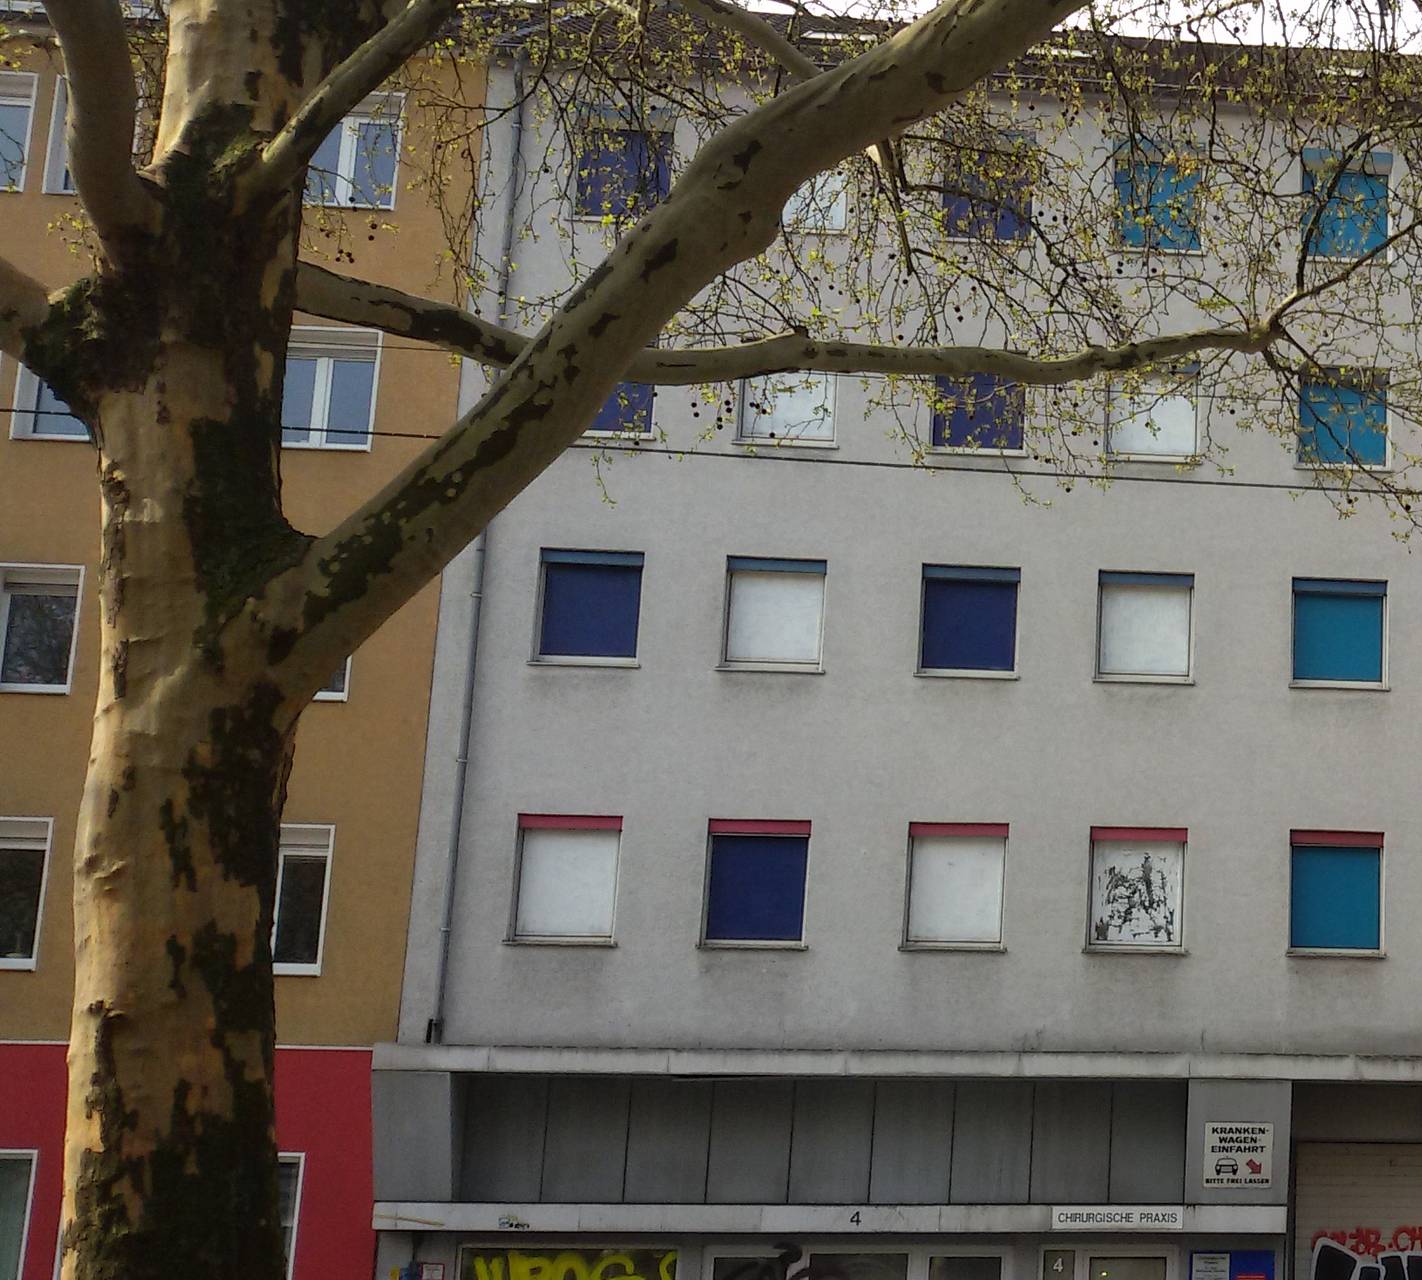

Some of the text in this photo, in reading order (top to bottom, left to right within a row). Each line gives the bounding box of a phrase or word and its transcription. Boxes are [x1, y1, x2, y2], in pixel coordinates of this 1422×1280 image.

[1211, 1126, 1269, 1135] KRANKEN-
[1210, 1145, 1266, 1153] EINFAHRT
[850, 1210, 862, 1226] 4
[1057, 1212, 1178, 1223] CHIRURGISCHE PRAXIS
[1053, 1256, 1064, 1273] 4
